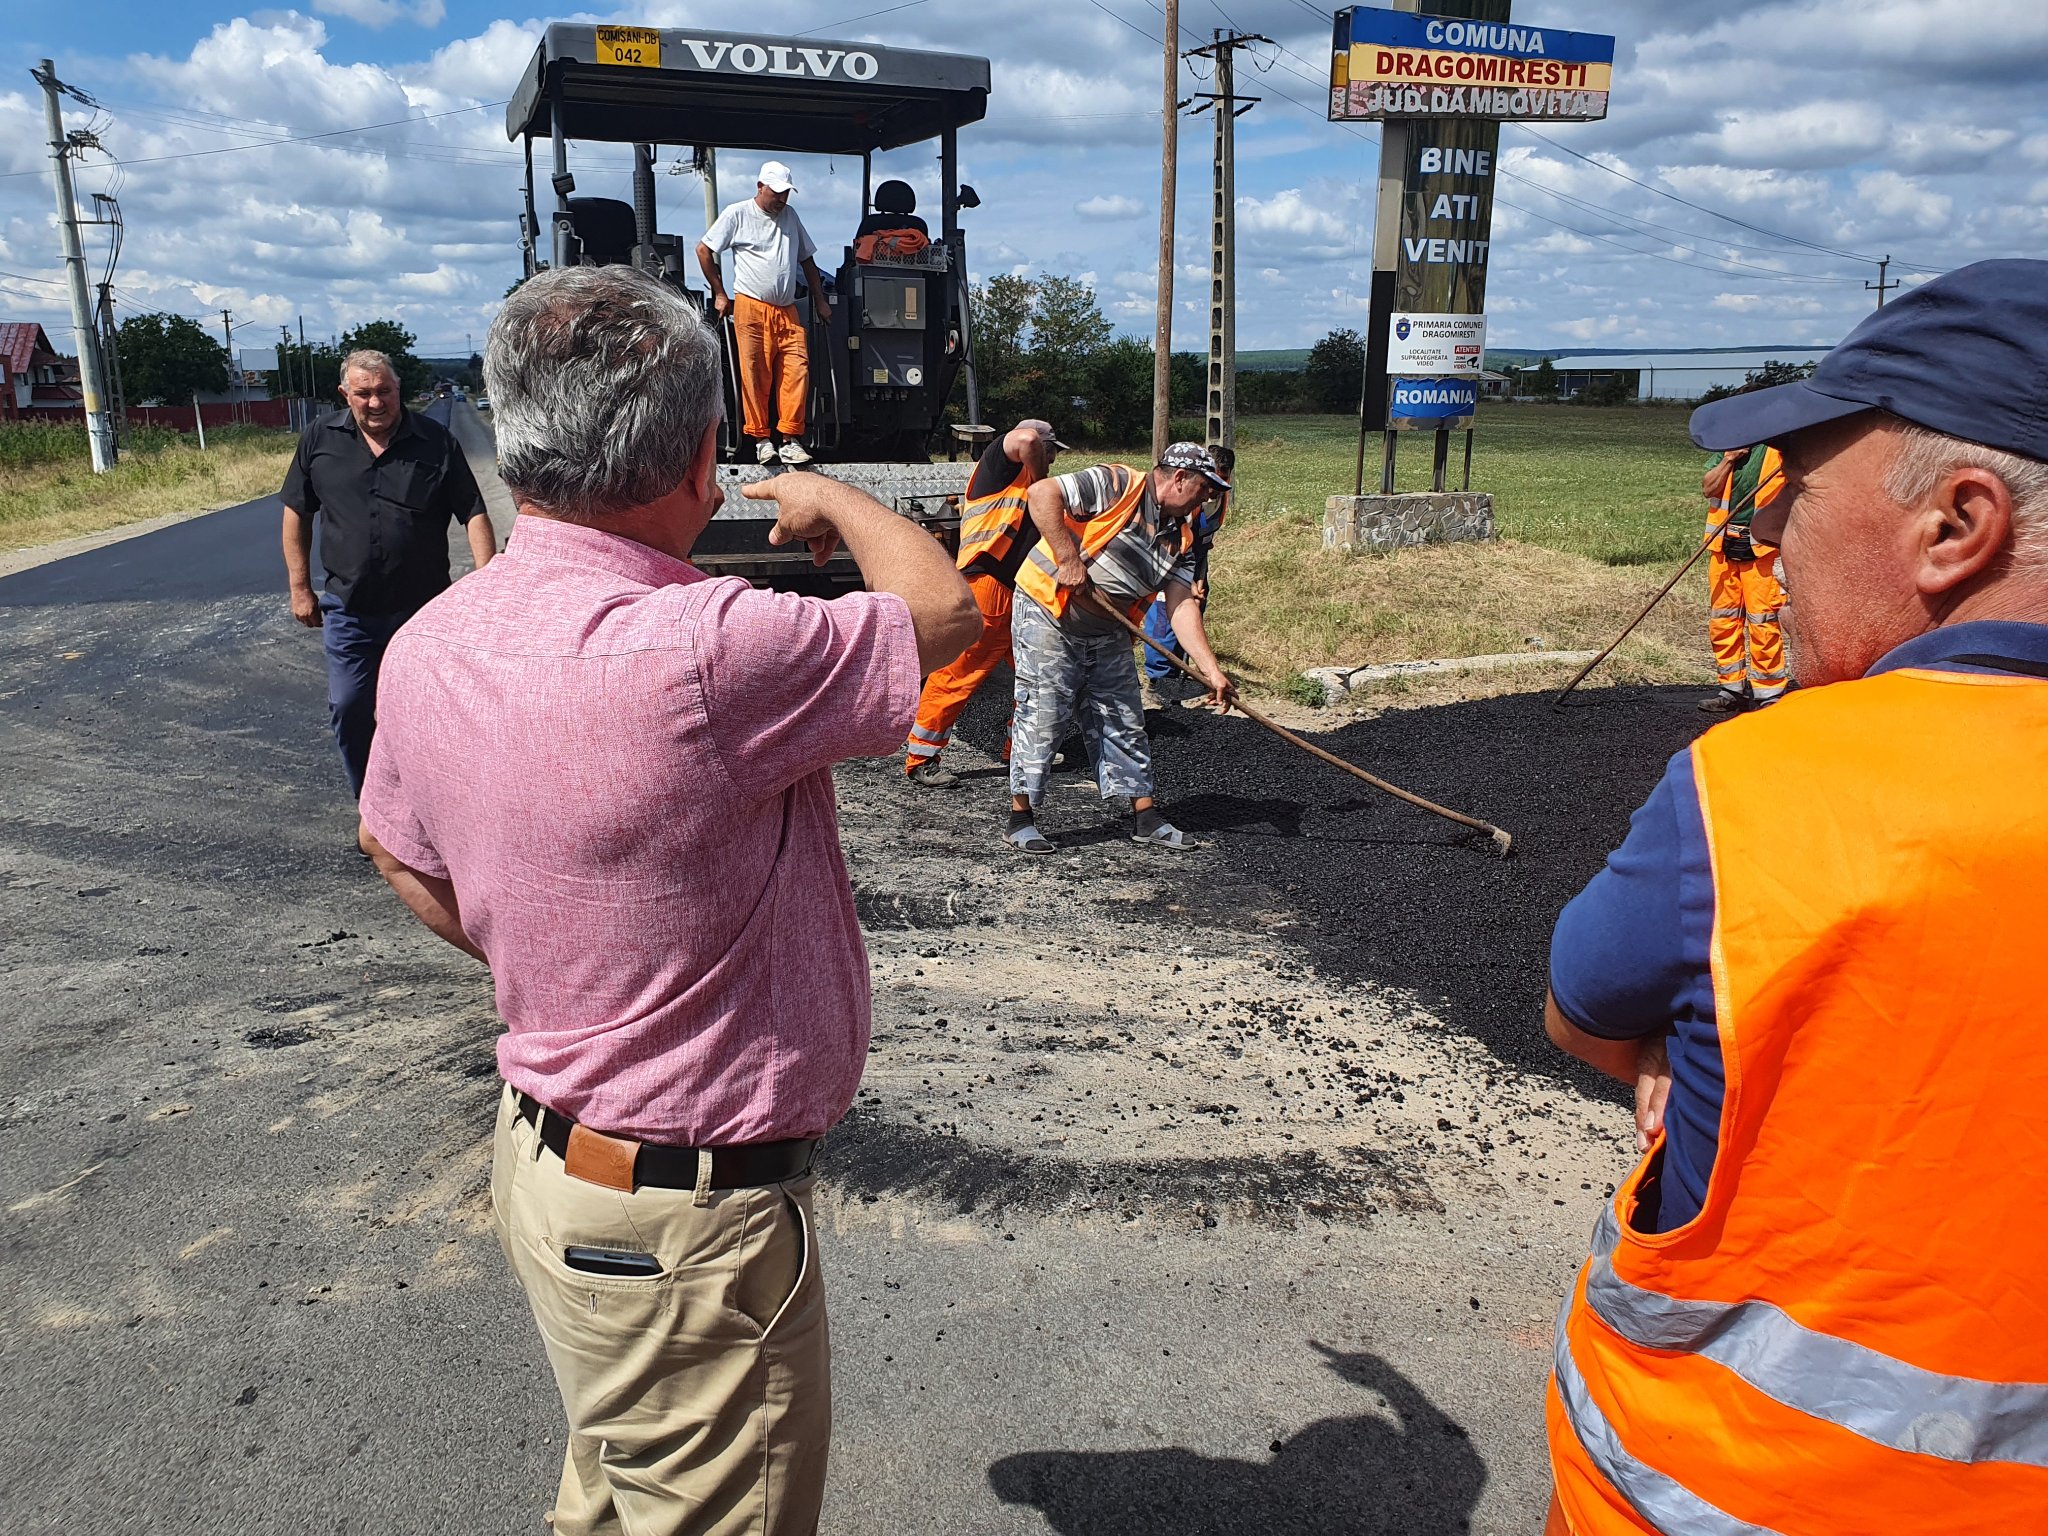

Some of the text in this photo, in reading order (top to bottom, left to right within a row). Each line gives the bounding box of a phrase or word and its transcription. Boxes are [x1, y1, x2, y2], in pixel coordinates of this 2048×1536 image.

[1426, 21, 1544, 54] COMUNA
[615, 47, 641, 63] 042
[681, 39, 879, 80] VOLVO
[1376, 51, 1587, 87] DRAGOMIRESTI
[1420, 147, 1491, 176] BINE
[1430, 193, 1478, 221] ATI
[1404, 238, 1489, 264] VENIT
[1395, 390, 1474, 404] ROMANIA
